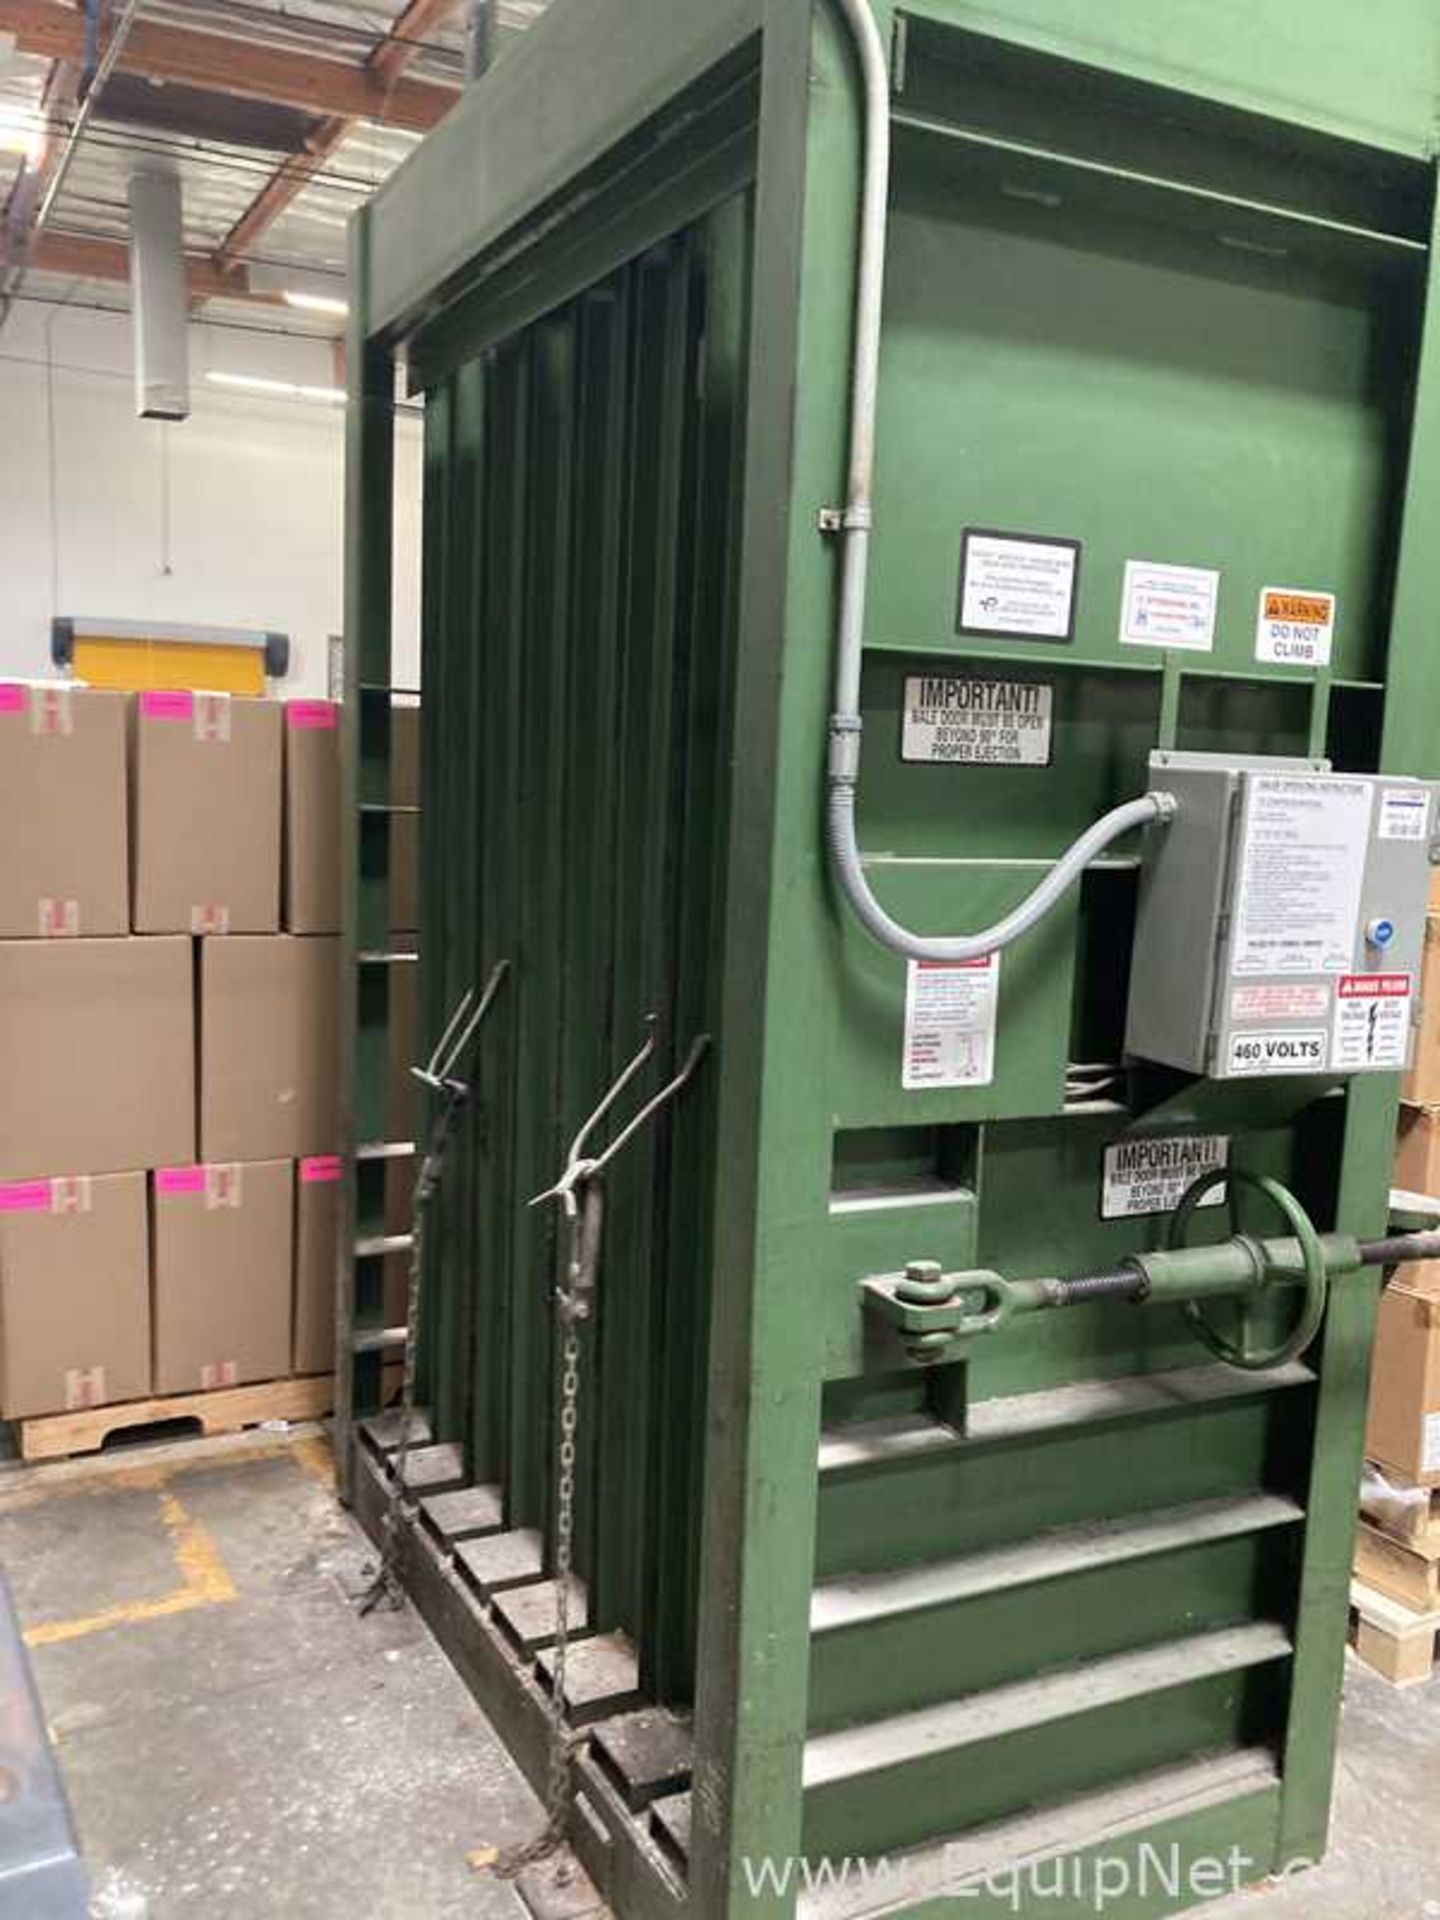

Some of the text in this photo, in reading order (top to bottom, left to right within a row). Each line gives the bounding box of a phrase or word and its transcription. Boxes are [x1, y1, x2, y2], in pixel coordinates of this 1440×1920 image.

[1271, 624, 1319, 641] DO NOT
[1274, 641, 1314, 659] CLIMB
[920, 681, 1039, 713] IMPORTANT!
[1018, 715, 1044, 730] OPEN
[936, 727, 976, 743] BEYOND
[1000, 730, 1018, 744] FOR
[931, 743, 1020, 760] PROPER EJECTION
[1234, 1041, 1320, 1059] 460 VOLTS
[1117, 1140, 1217, 1170] IMPORTANT!
